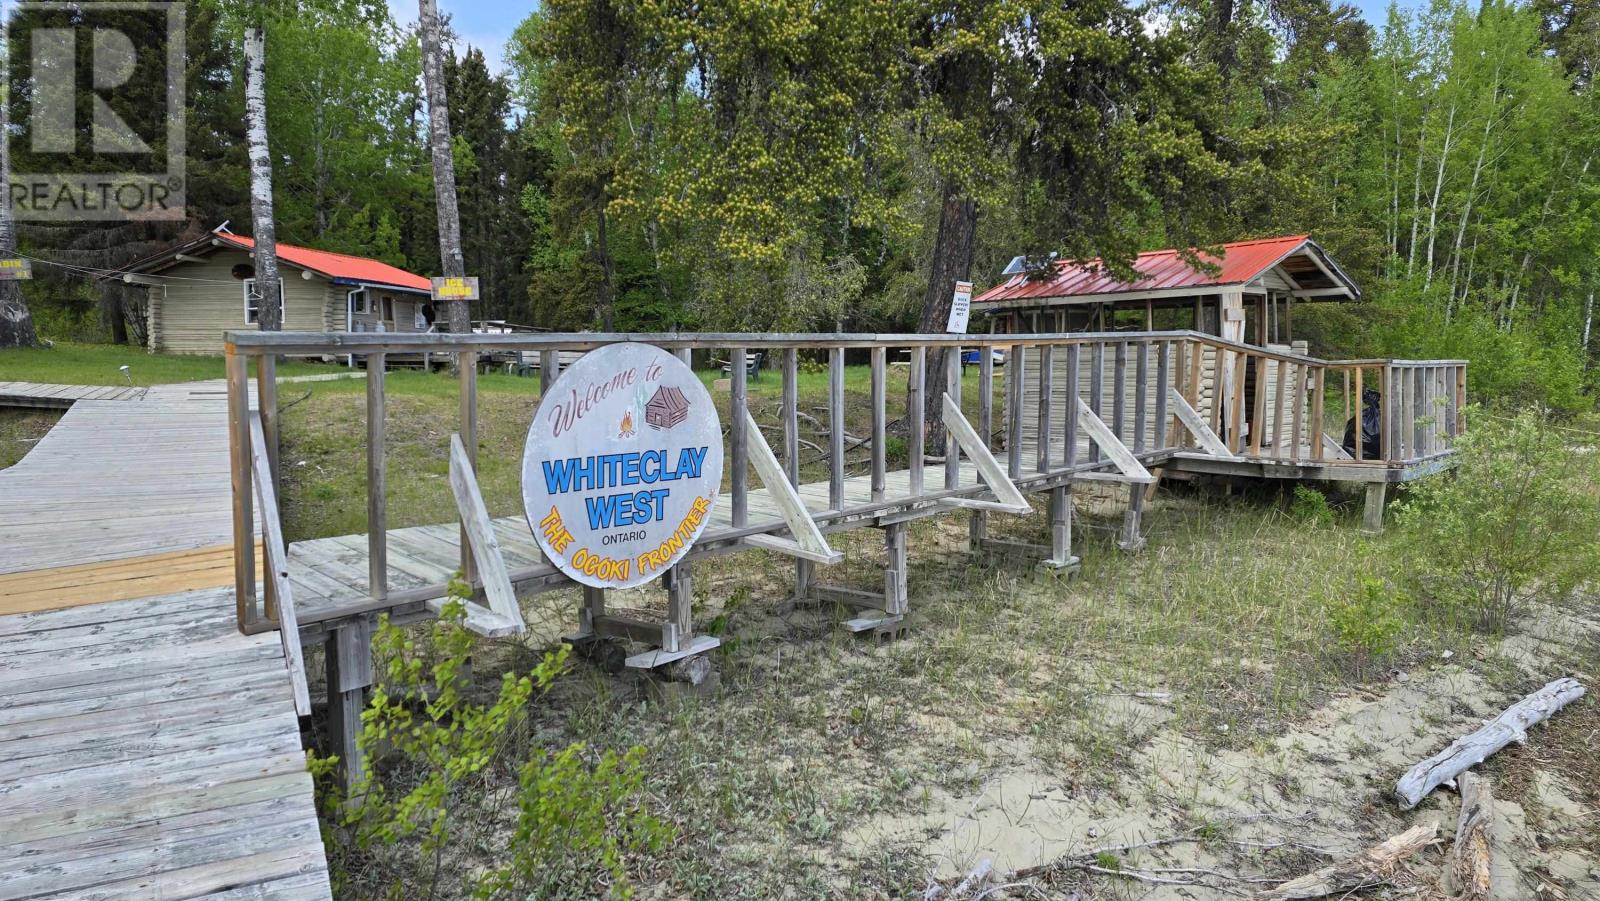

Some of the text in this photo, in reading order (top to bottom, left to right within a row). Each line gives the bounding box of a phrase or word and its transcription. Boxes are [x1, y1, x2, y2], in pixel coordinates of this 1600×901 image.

[548, 356, 663, 438] Welcome to
[542, 446, 709, 494] WHITECLAY
[585, 488, 669, 530] WEST
[539, 495, 711, 582] THE OGOKI FRONTIER
[602, 530, 647, 546] ONTARIO
